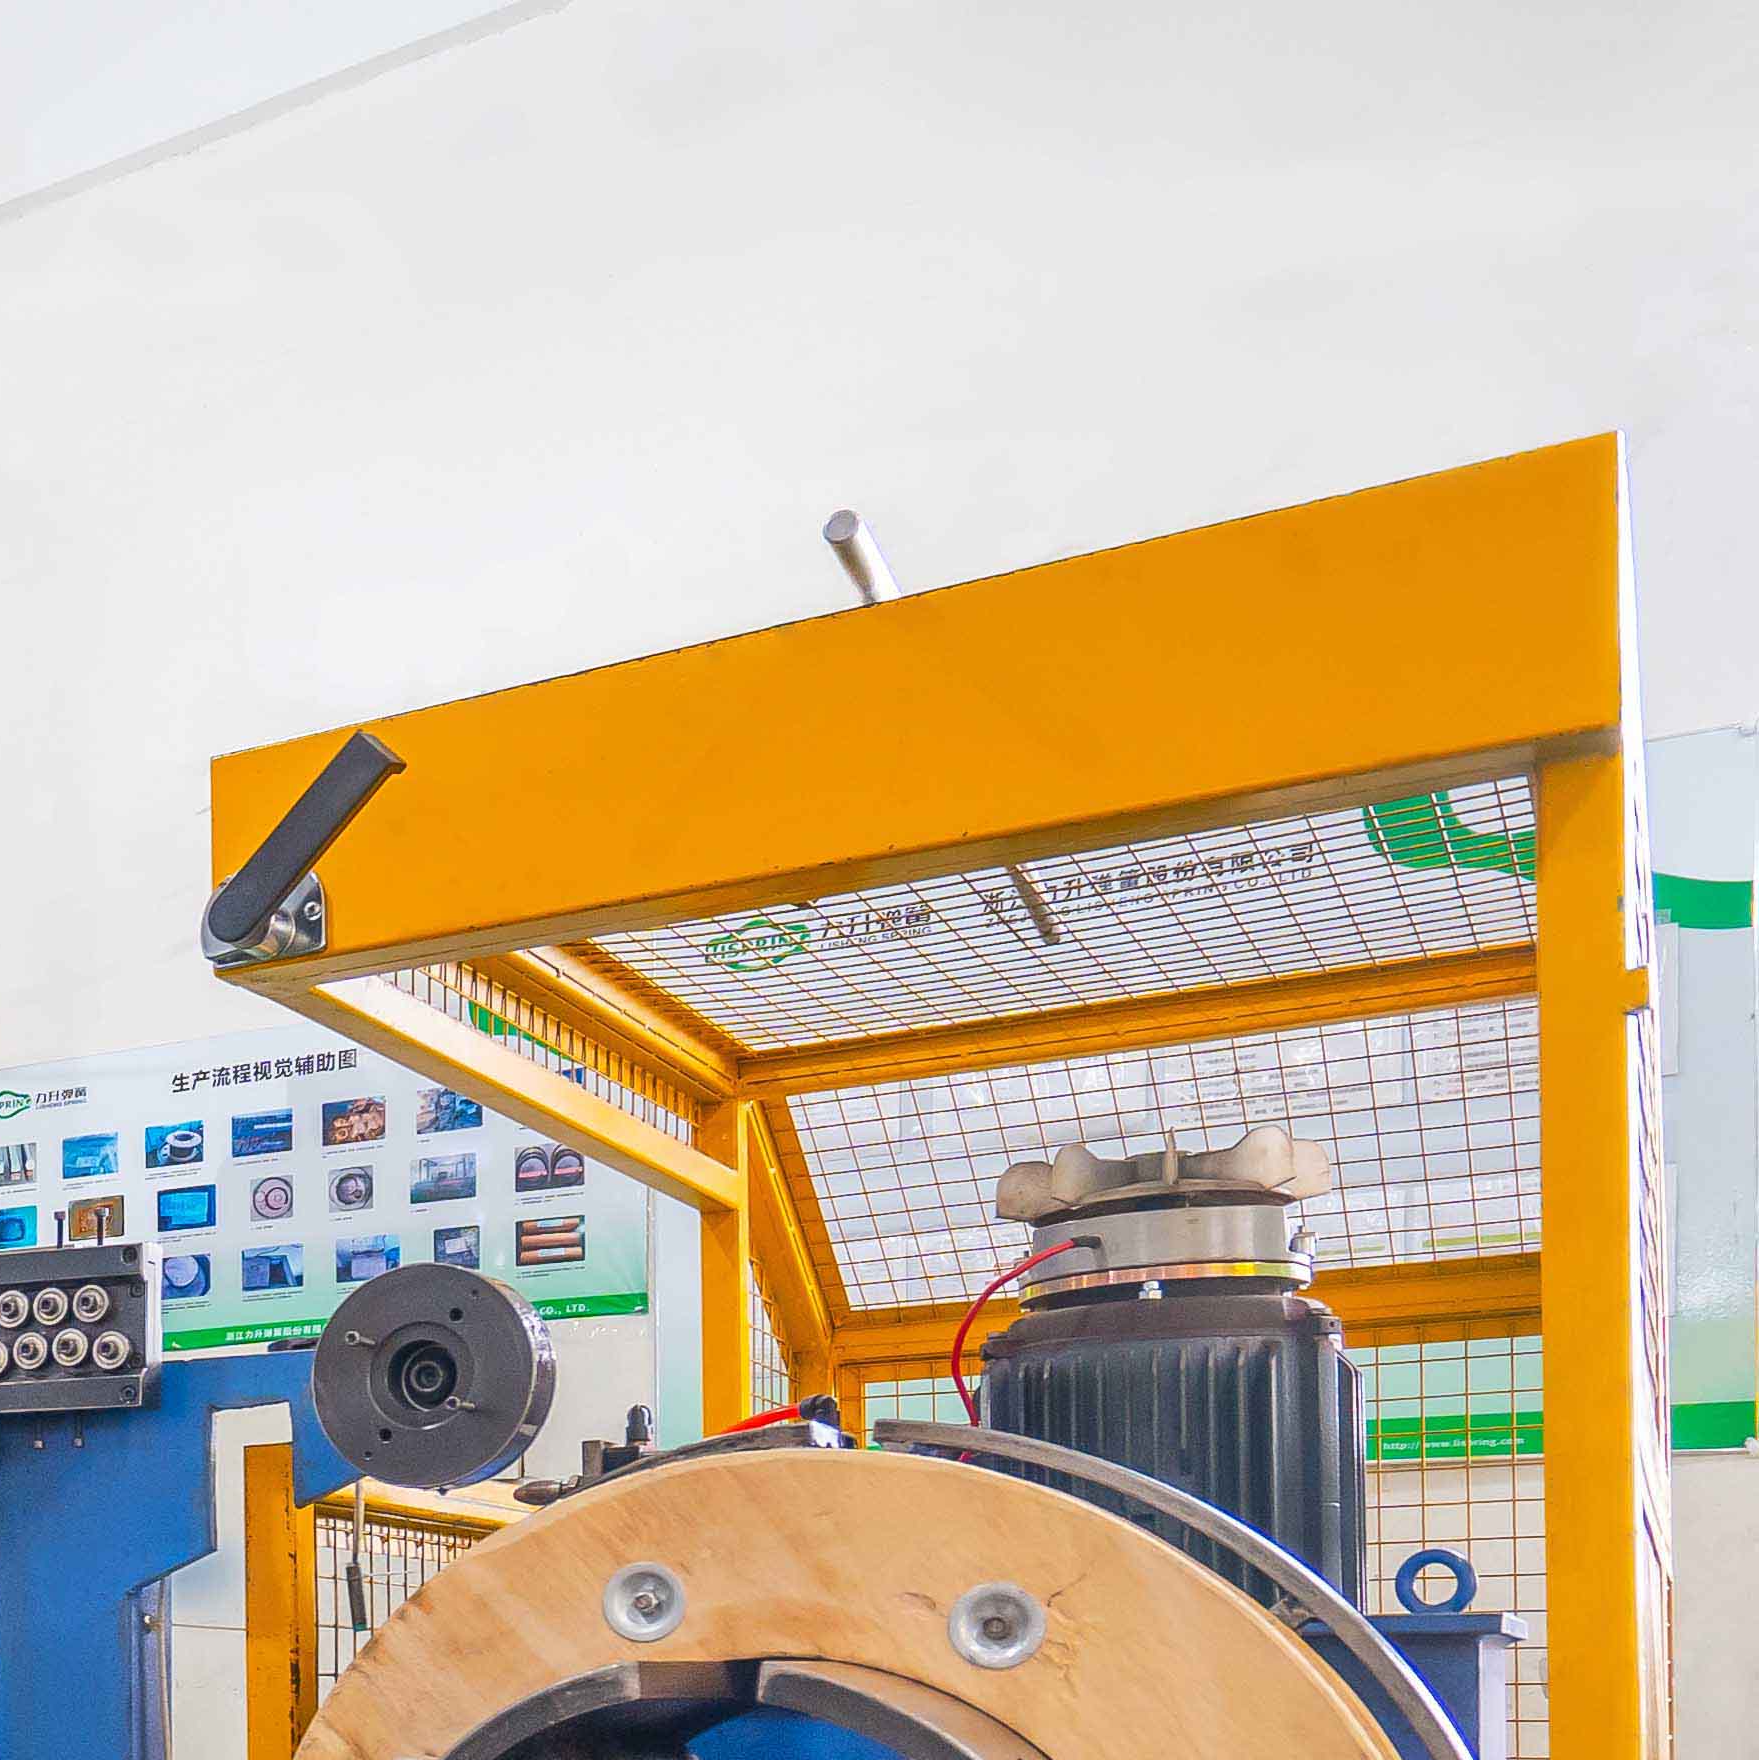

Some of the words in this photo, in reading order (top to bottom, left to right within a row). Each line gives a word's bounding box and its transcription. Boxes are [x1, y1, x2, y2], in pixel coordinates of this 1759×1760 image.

[171, 1048, 357, 1093] 生产流程视觉辅助图
